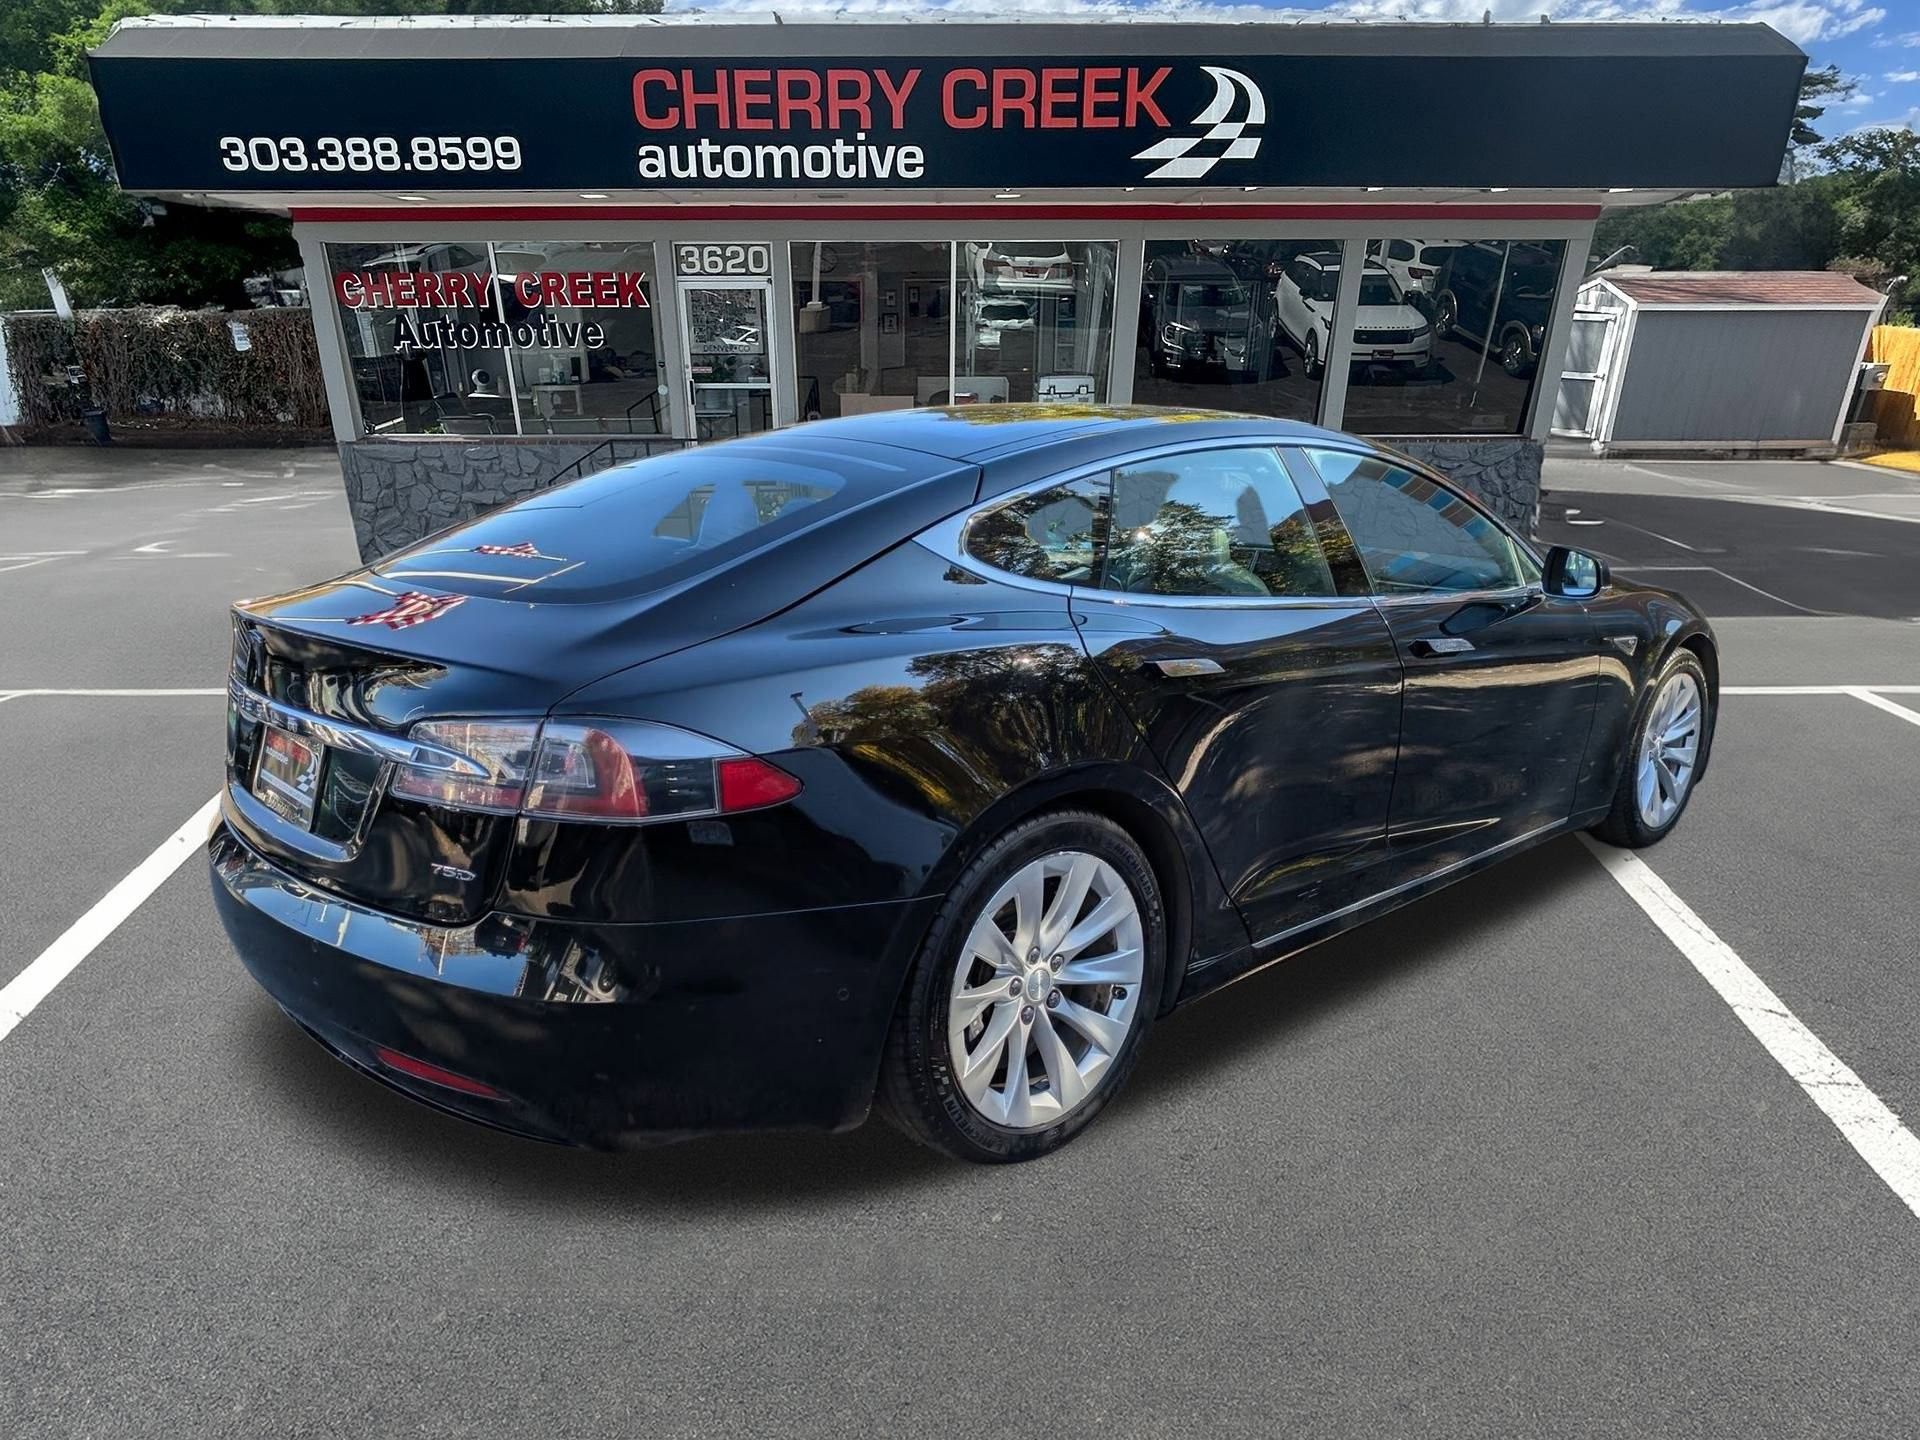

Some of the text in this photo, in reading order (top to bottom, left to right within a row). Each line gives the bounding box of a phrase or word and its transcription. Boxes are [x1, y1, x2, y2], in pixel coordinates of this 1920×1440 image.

[632, 67, 1174, 129] CHERRY CREEK
[219, 136, 522, 172] 303.388.8599
[638, 132, 924, 179] automotive
[680, 245, 768, 274] 3620
[334, 271, 651, 309] CHERRY CREEK
[393, 312, 605, 350] Automotive
[431, 863, 476, 881] 75D
